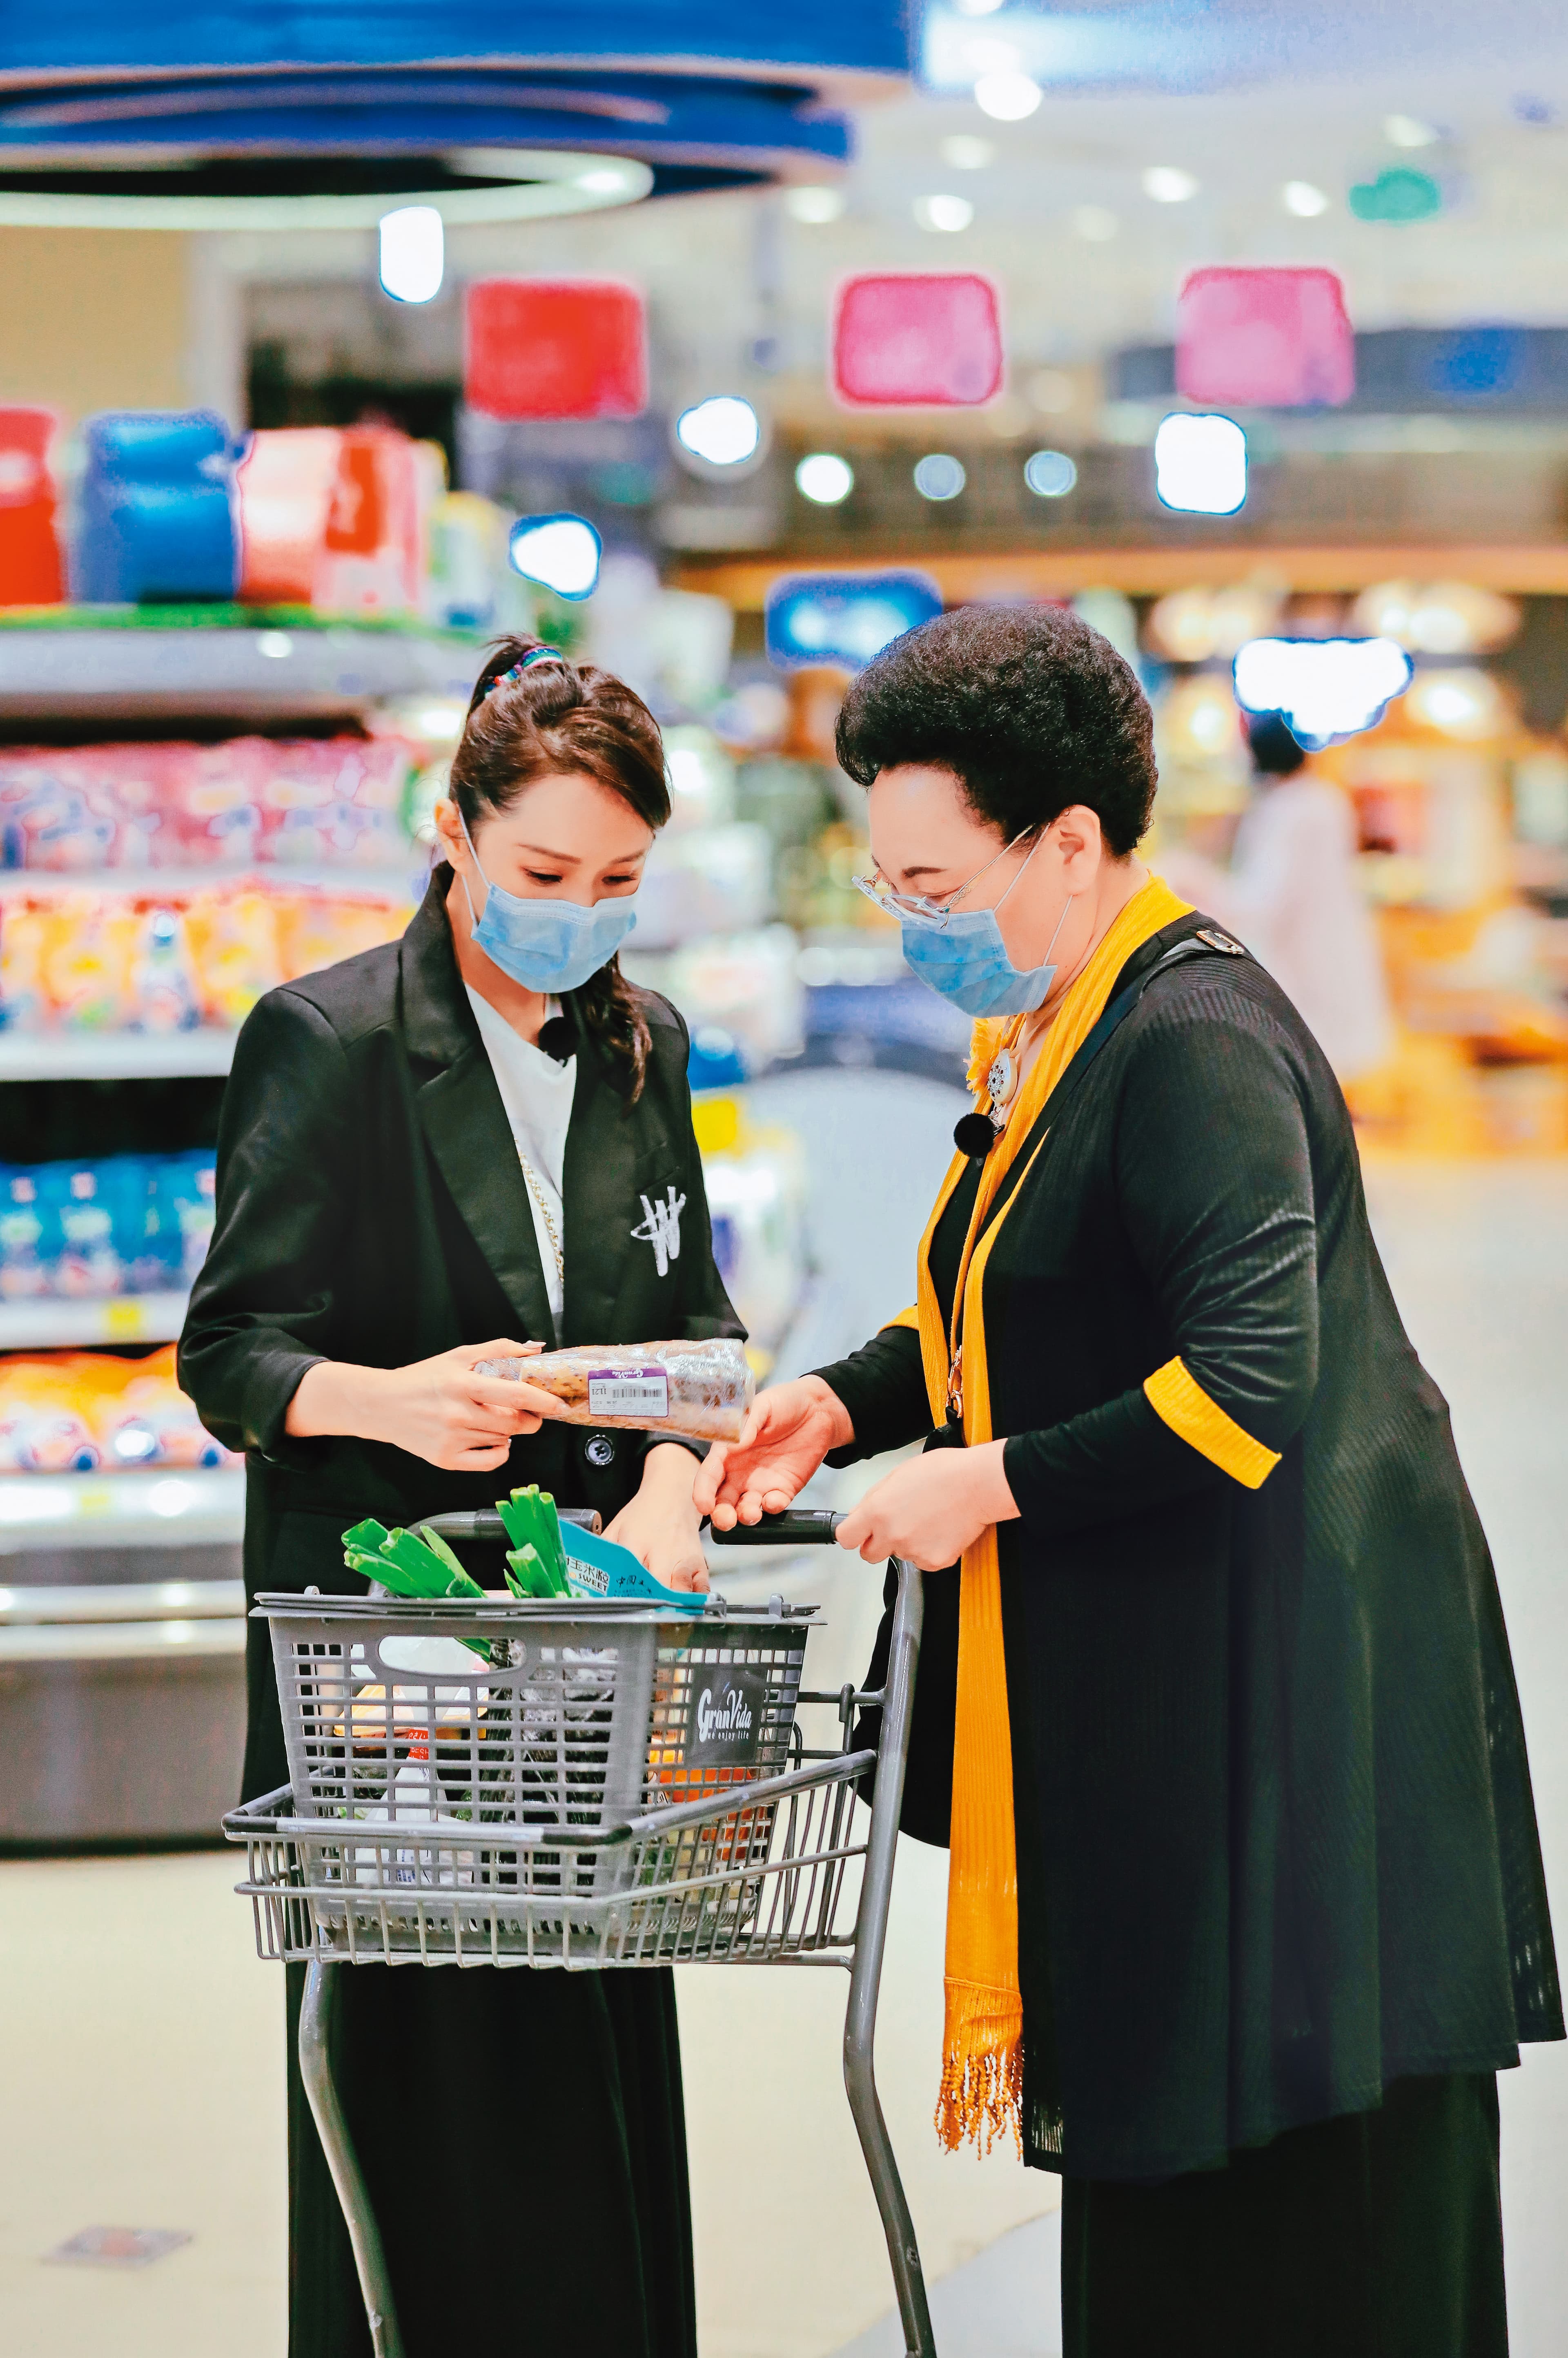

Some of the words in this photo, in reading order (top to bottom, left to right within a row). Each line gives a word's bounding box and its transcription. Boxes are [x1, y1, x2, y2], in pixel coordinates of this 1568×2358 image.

[579, 1573, 608, 1591] SWEET
[697, 1689, 752, 1742] GranVida
[718, 1731, 735, 1741] enjoy
[738, 1730, 749, 1739] life
